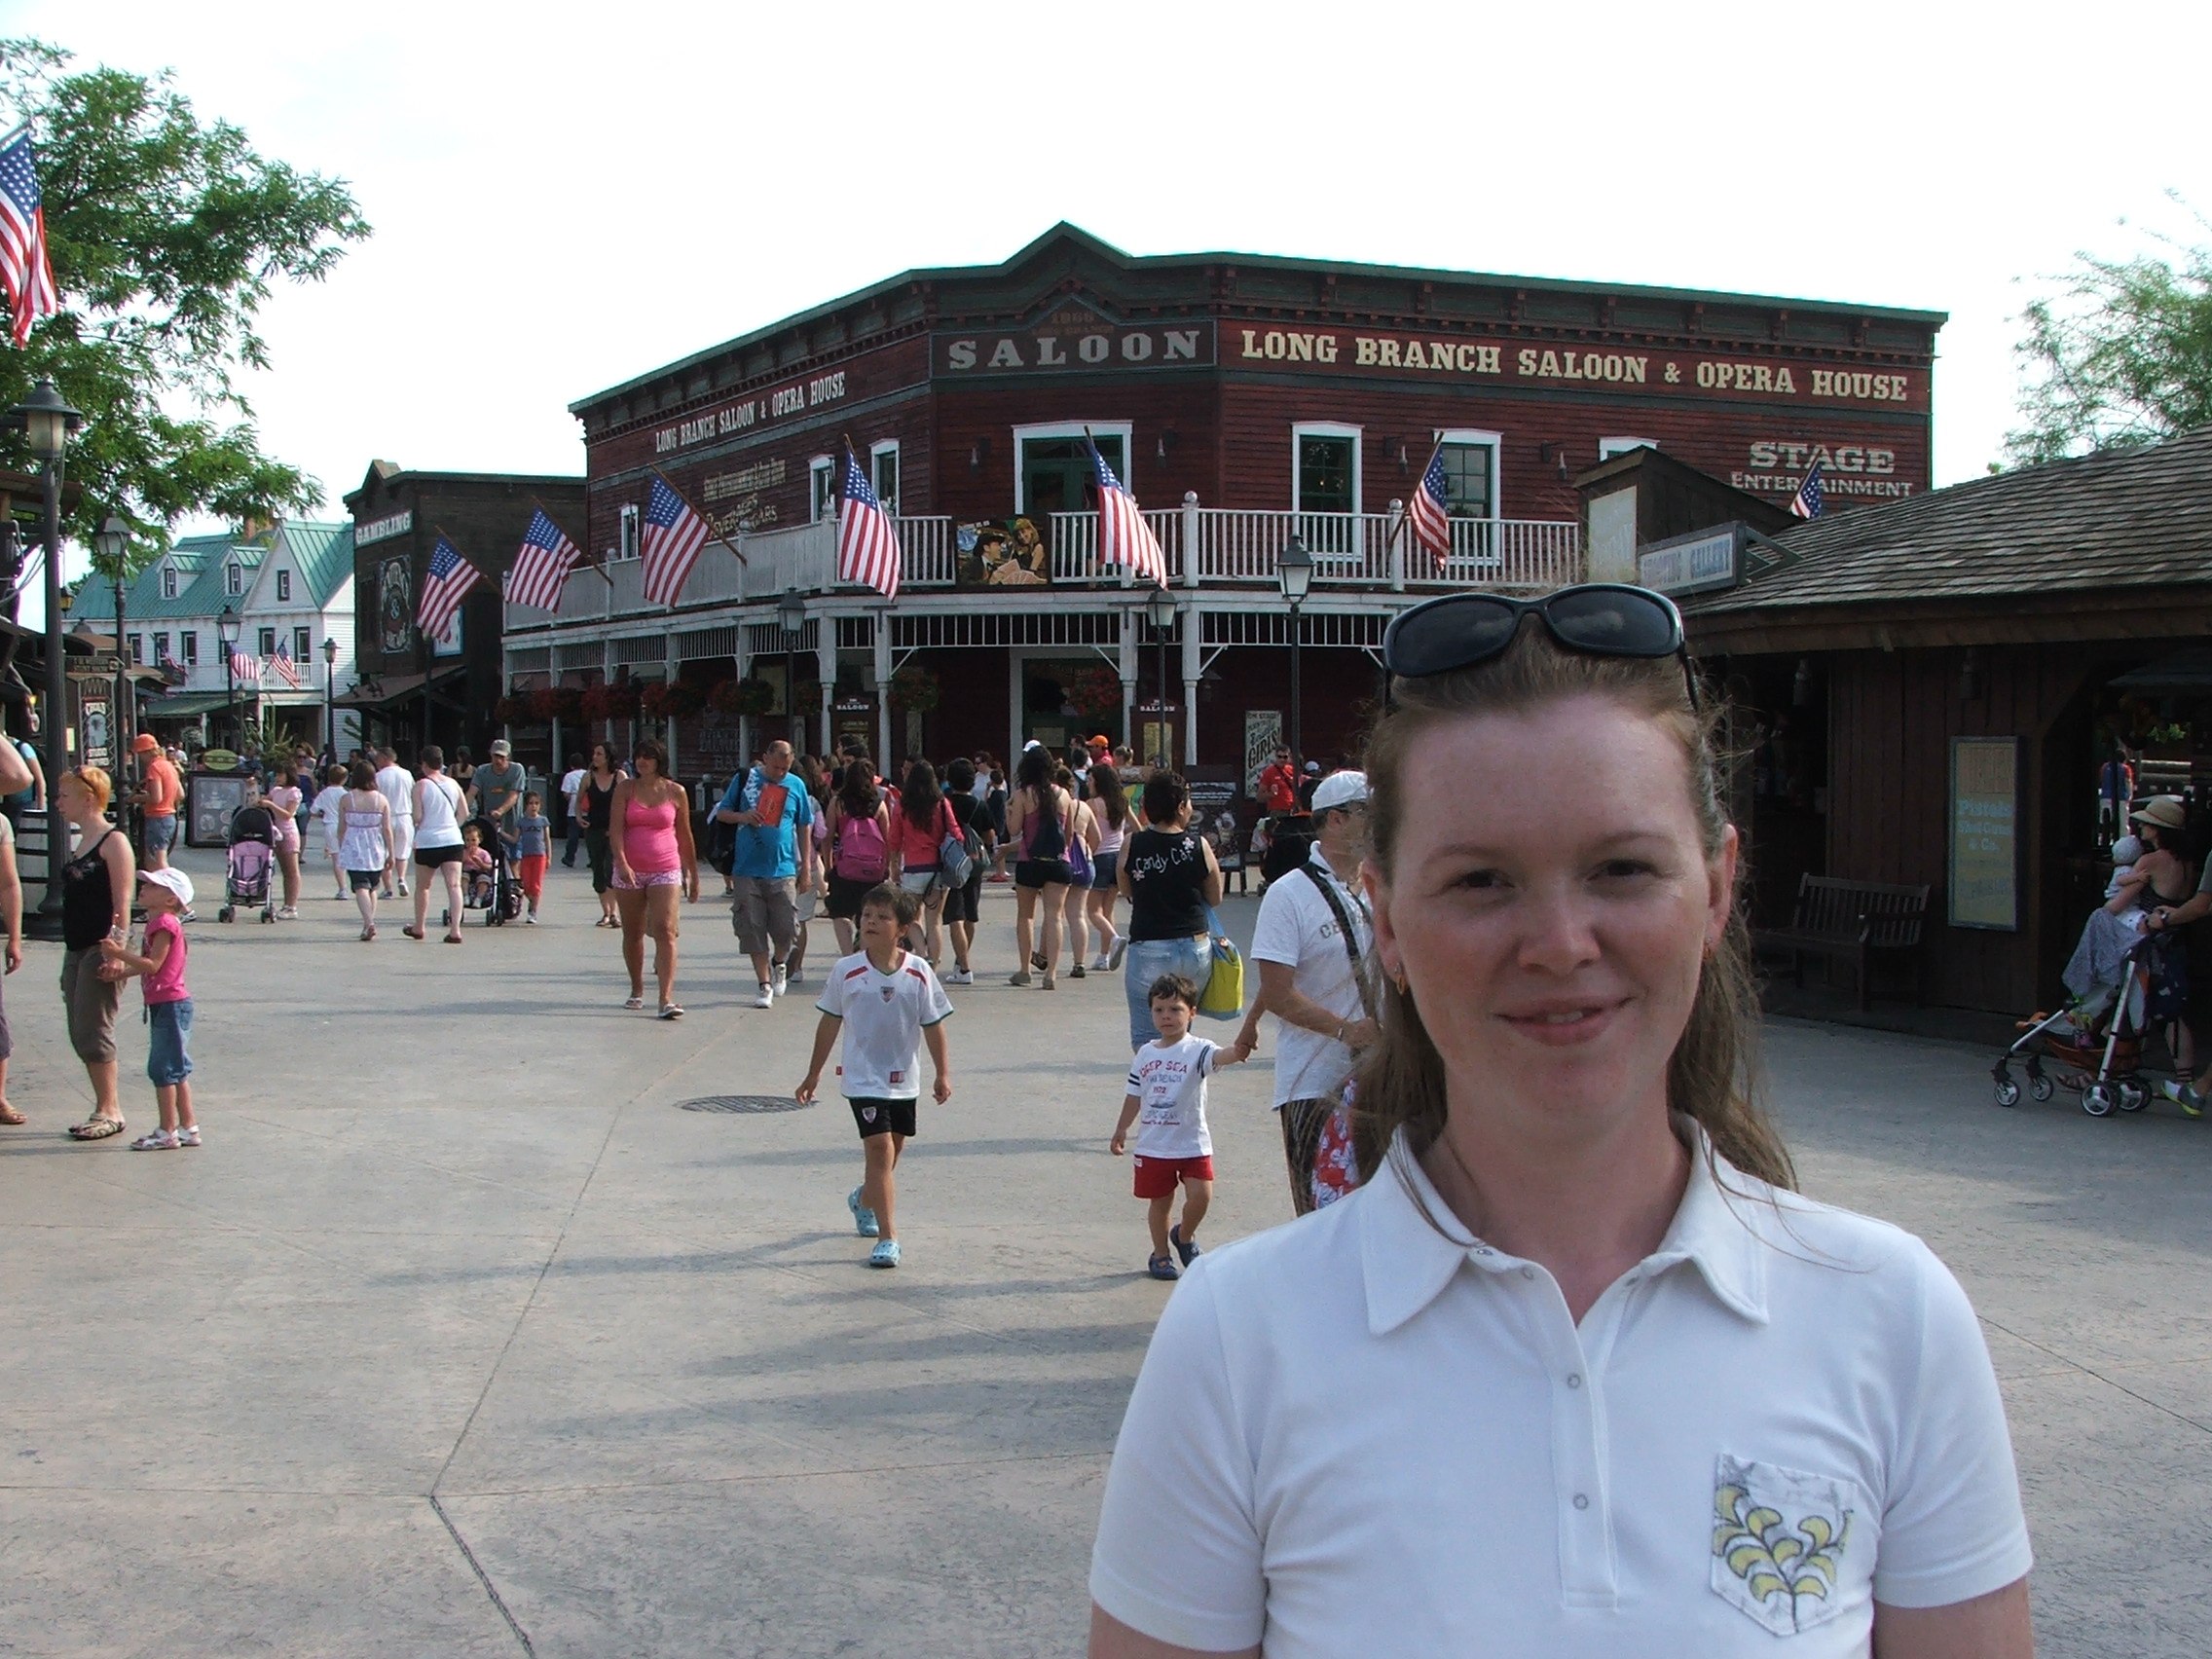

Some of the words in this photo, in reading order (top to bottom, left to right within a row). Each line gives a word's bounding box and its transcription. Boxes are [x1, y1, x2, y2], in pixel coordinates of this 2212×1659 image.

[948, 330, 1199, 370] SALOON
[1241, 330, 1339, 363] LONG
[1355, 337, 1501, 374] BRANCH
[1518, 349, 1647, 383] SALOON
[1665, 362, 1680, 384] &
[1697, 361, 1796, 394] OPERA
[1812, 370, 1907, 401] HOUSE
[655, 427, 677, 453] LONG
[681, 414, 716, 446] BRANCH
[719, 401, 755, 434] SALOON
[759, 400, 766, 420] &
[772, 386, 804, 418] OPERA
[810, 371, 845, 406] HOUSE
[1750, 440, 1896, 474] STAGE
[1731, 471, 1913, 498] ENTERAINMENT
[355, 512, 411, 545] GAMBLING
[1135, 853, 1169, 874] Candy
[1165, 1060, 1188, 1074] SEA
